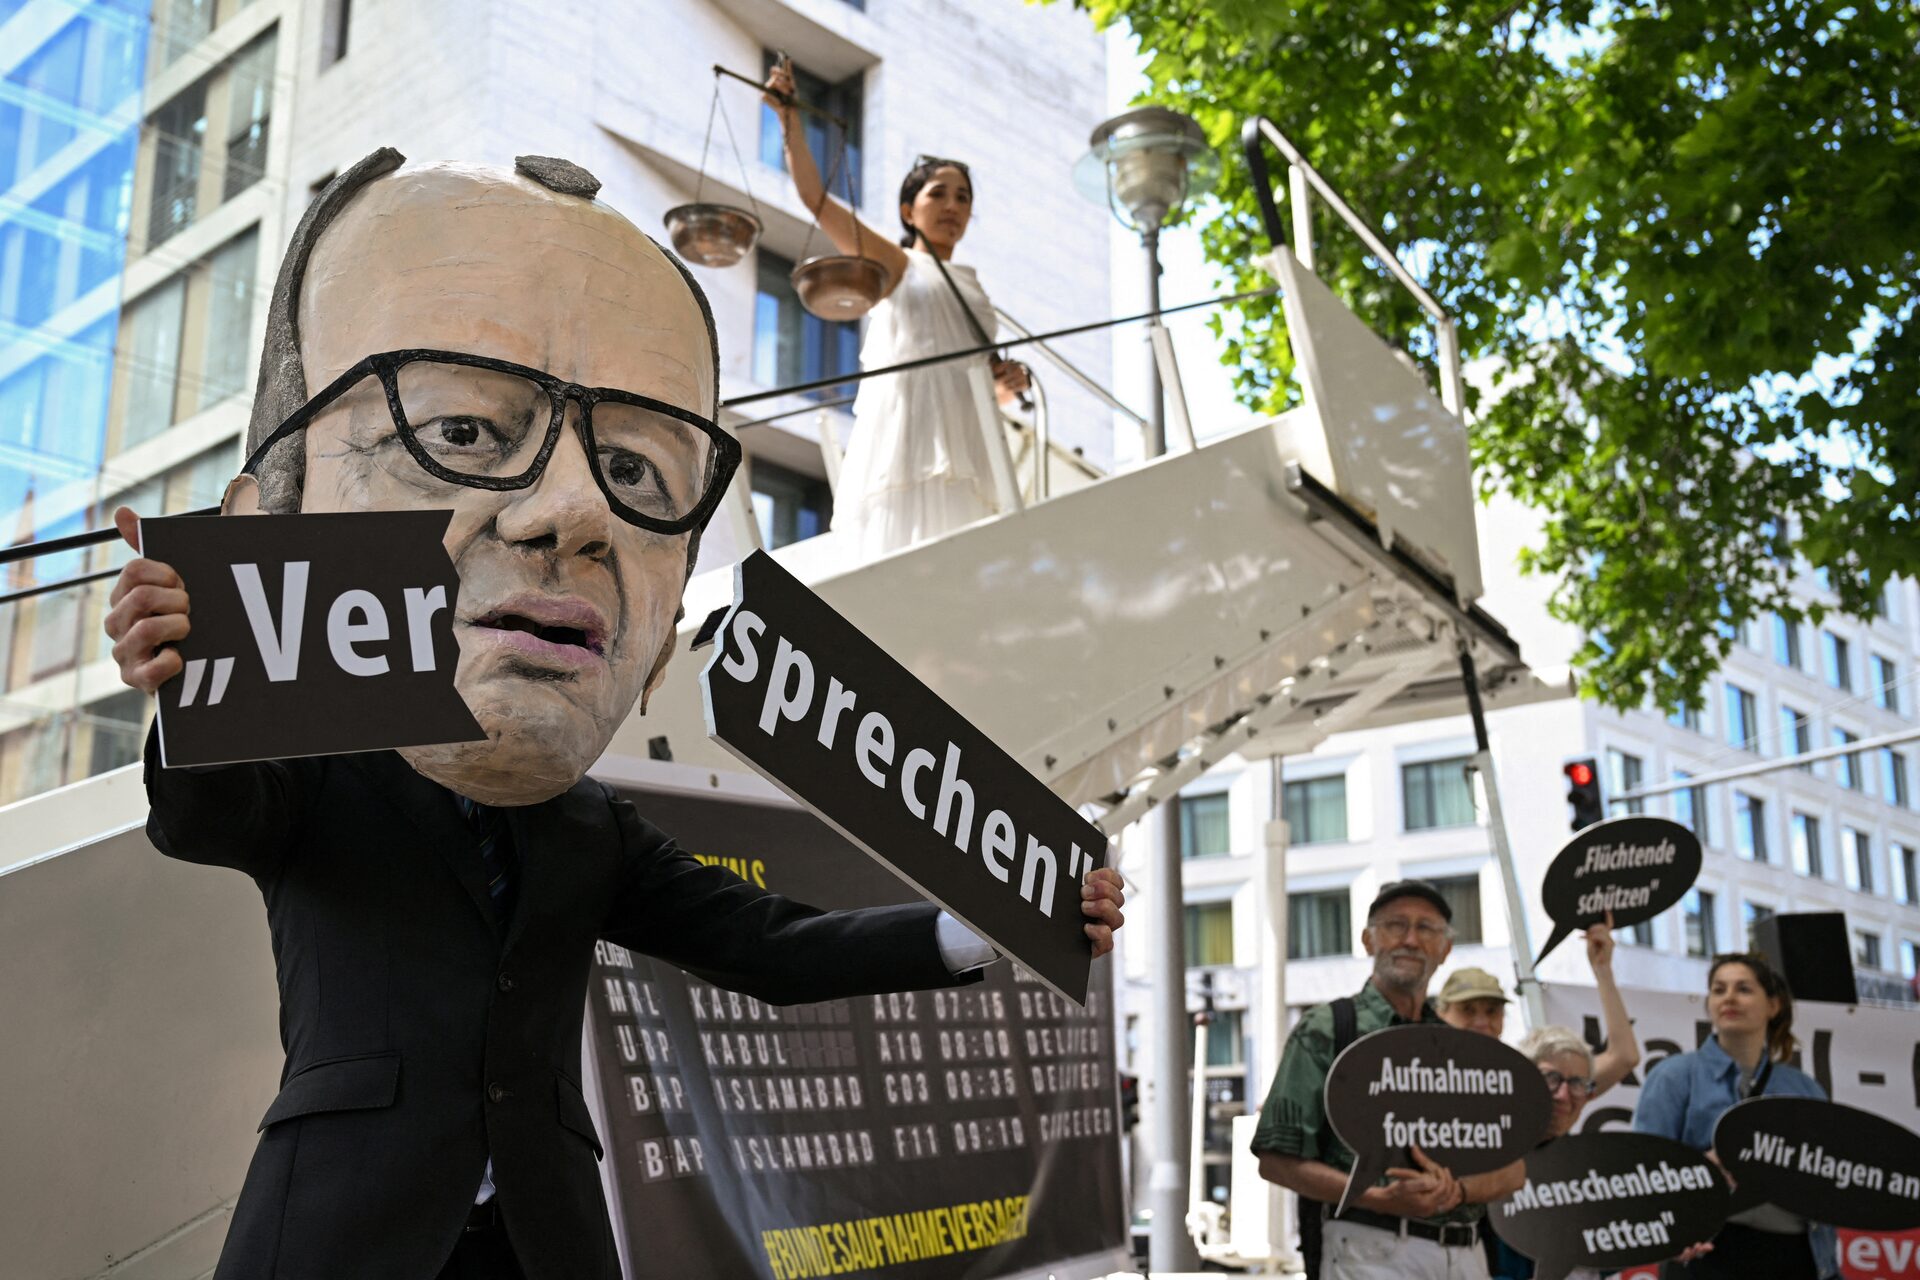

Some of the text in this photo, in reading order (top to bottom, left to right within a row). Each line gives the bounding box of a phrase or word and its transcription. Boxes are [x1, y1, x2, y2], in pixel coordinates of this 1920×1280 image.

[690, 985, 779, 1021] KABUL
[934, 992, 1005, 1019] 07:15
[701, 1033, 787, 1065] KABUL
[630, 1076, 684, 1112] BAP
[715, 1076, 862, 1110] ISLAMABAD
[733, 1131, 873, 1171] ISLAMABAD
[895, 1125, 938, 1158] F11
[1798, 1142, 1884, 1192] klagen
